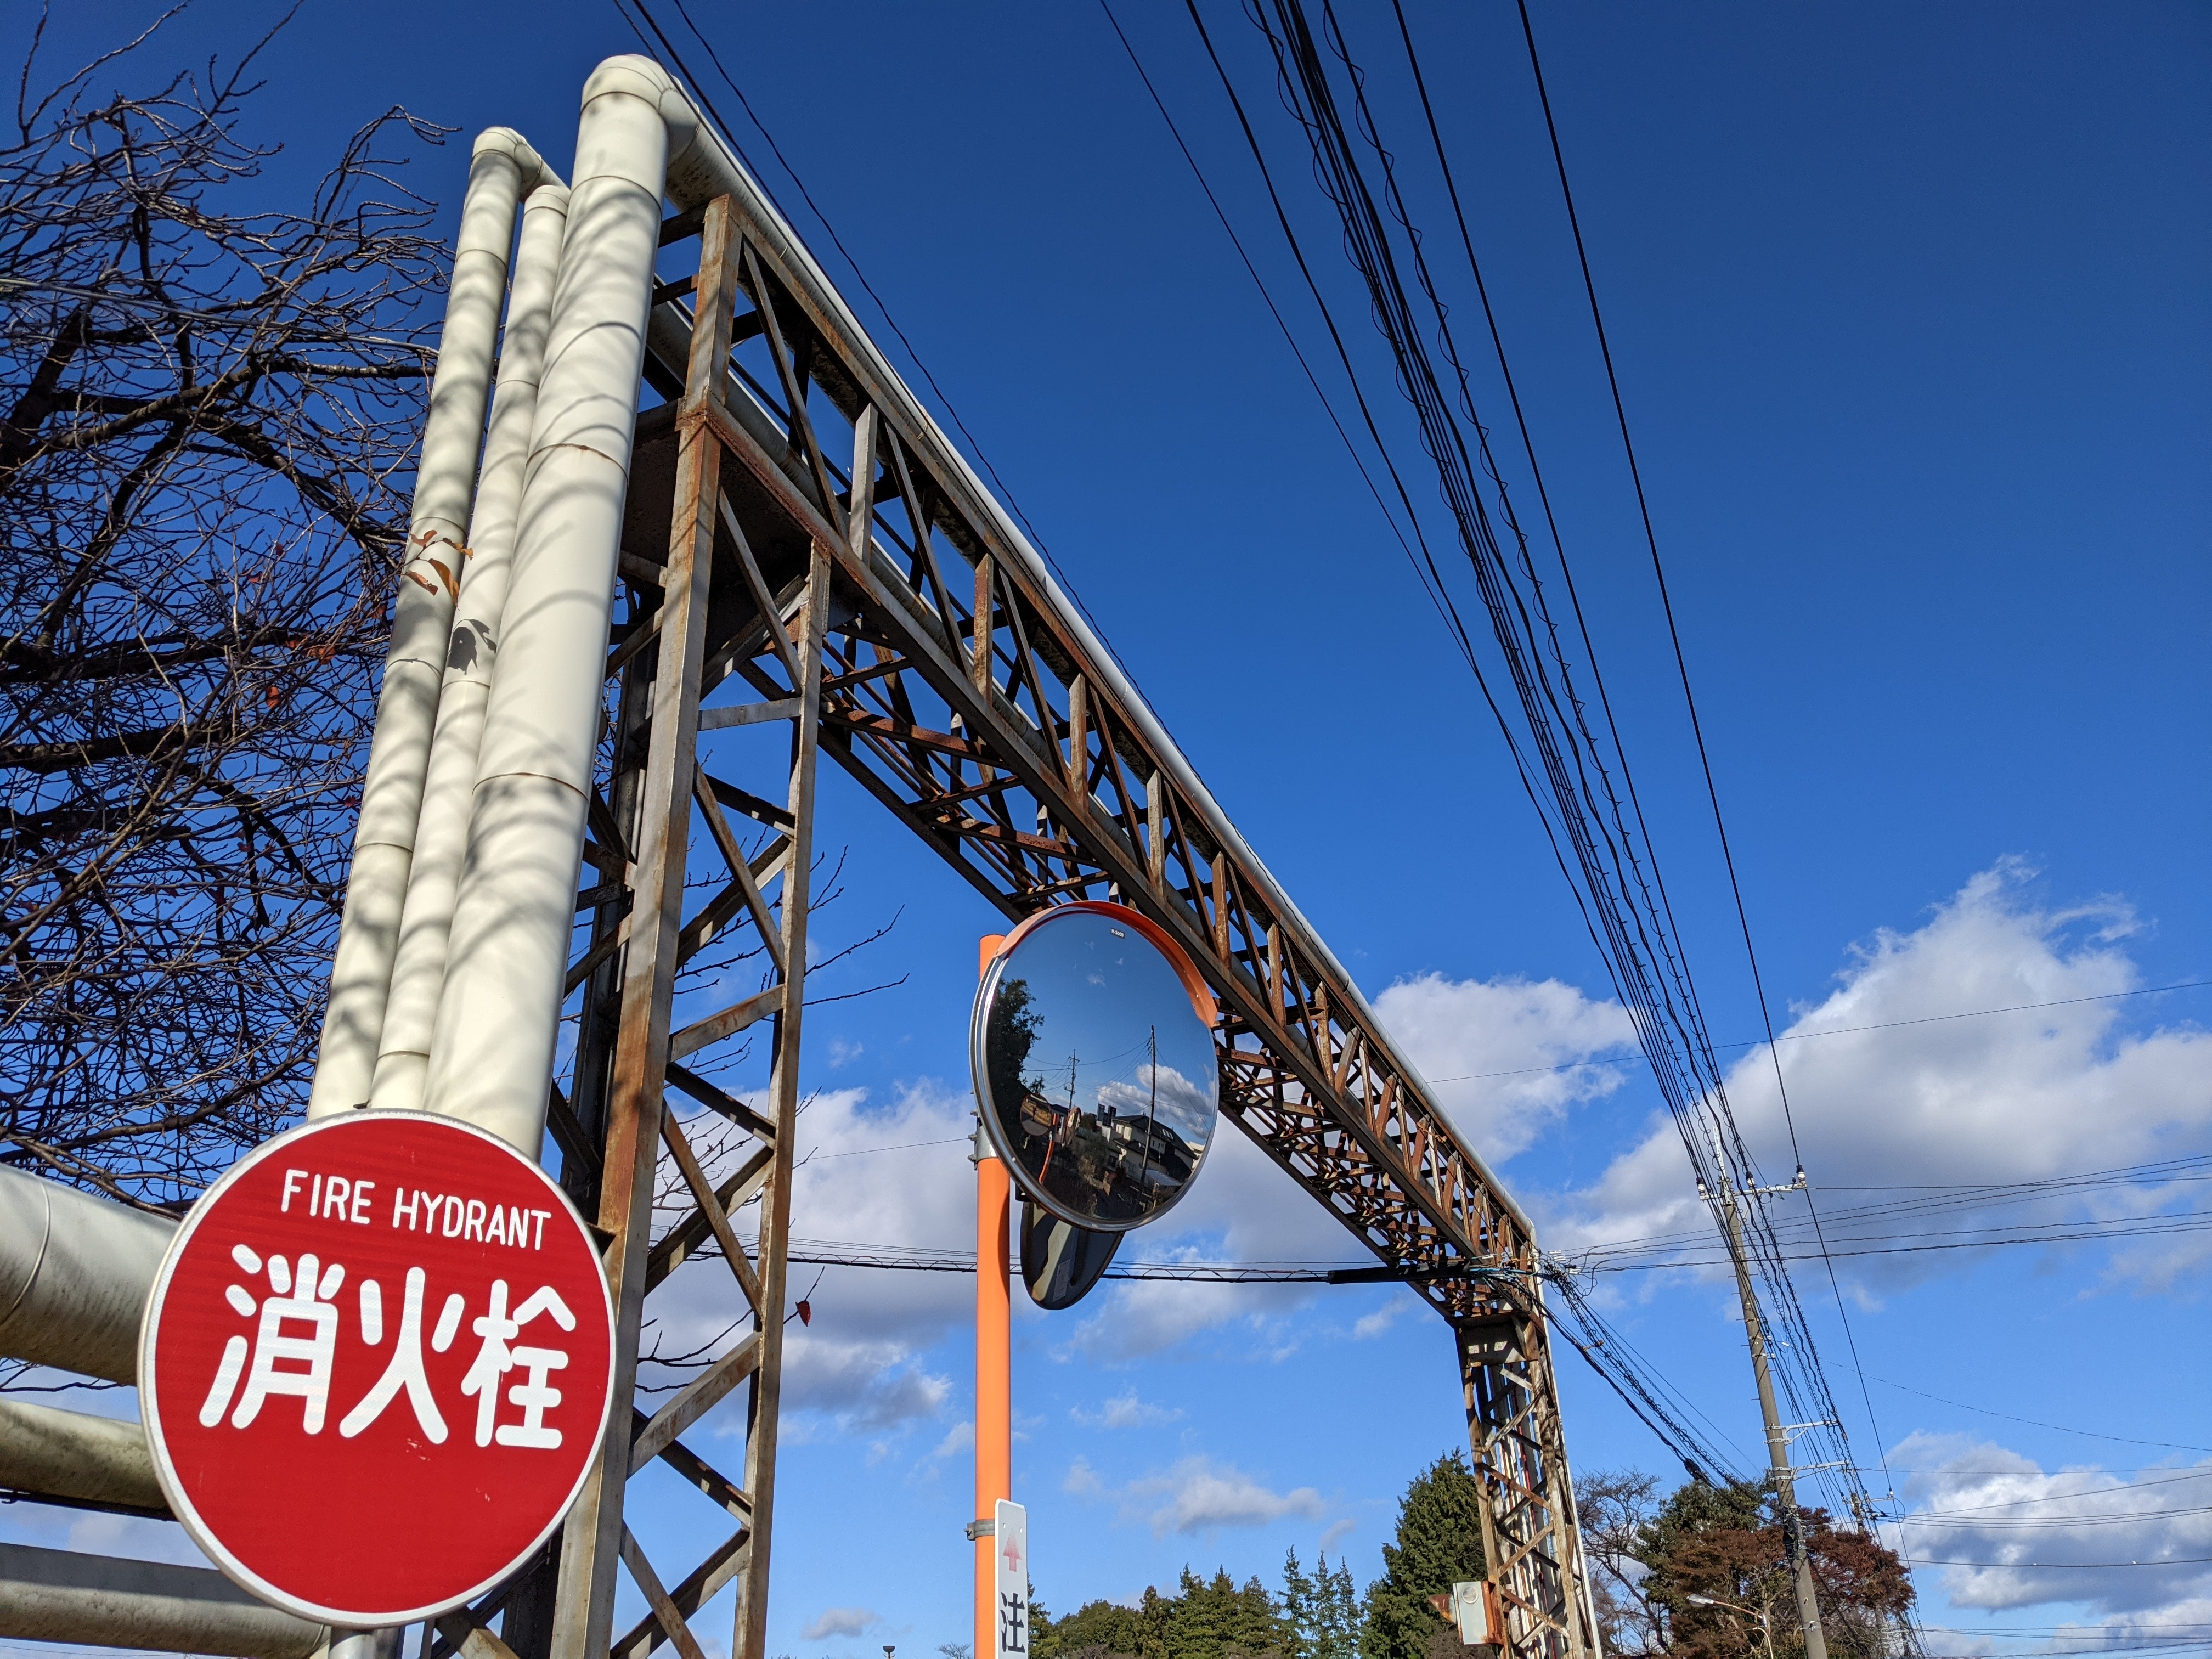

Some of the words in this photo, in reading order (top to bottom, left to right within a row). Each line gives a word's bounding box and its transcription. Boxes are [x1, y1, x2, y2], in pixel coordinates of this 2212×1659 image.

[281, 1169, 375, 1224] FIRE
[393, 1187, 552, 1251] HYDRANT
[199, 1244, 577, 1449] 消火栓
[1000, 1591, 1026, 1654] 注
